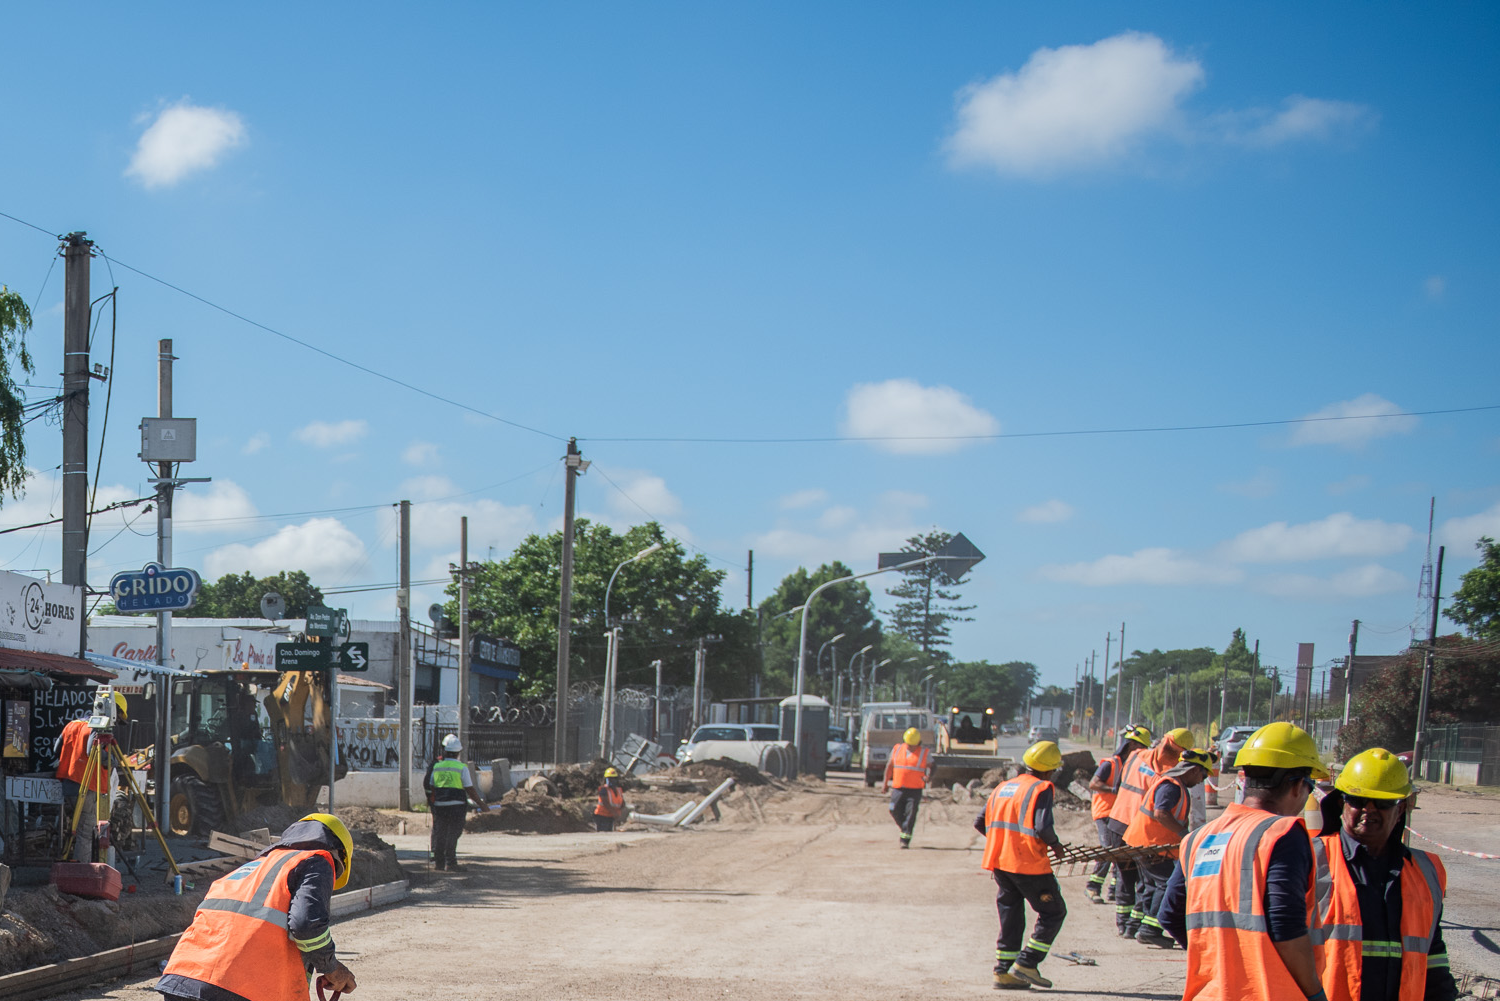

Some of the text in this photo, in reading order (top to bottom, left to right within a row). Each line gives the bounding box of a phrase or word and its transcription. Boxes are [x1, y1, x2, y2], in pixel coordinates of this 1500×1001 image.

[115, 575, 190, 597] GRIDO
[30, 597, 75, 621] 24 HORAS
[120, 595, 186, 608] HELADO
[112, 641, 176, 661] Carlis
[294, 649, 320, 658] Domingo
[34, 689, 95, 707] HELADOS
[356, 722, 400, 742] SLOT
